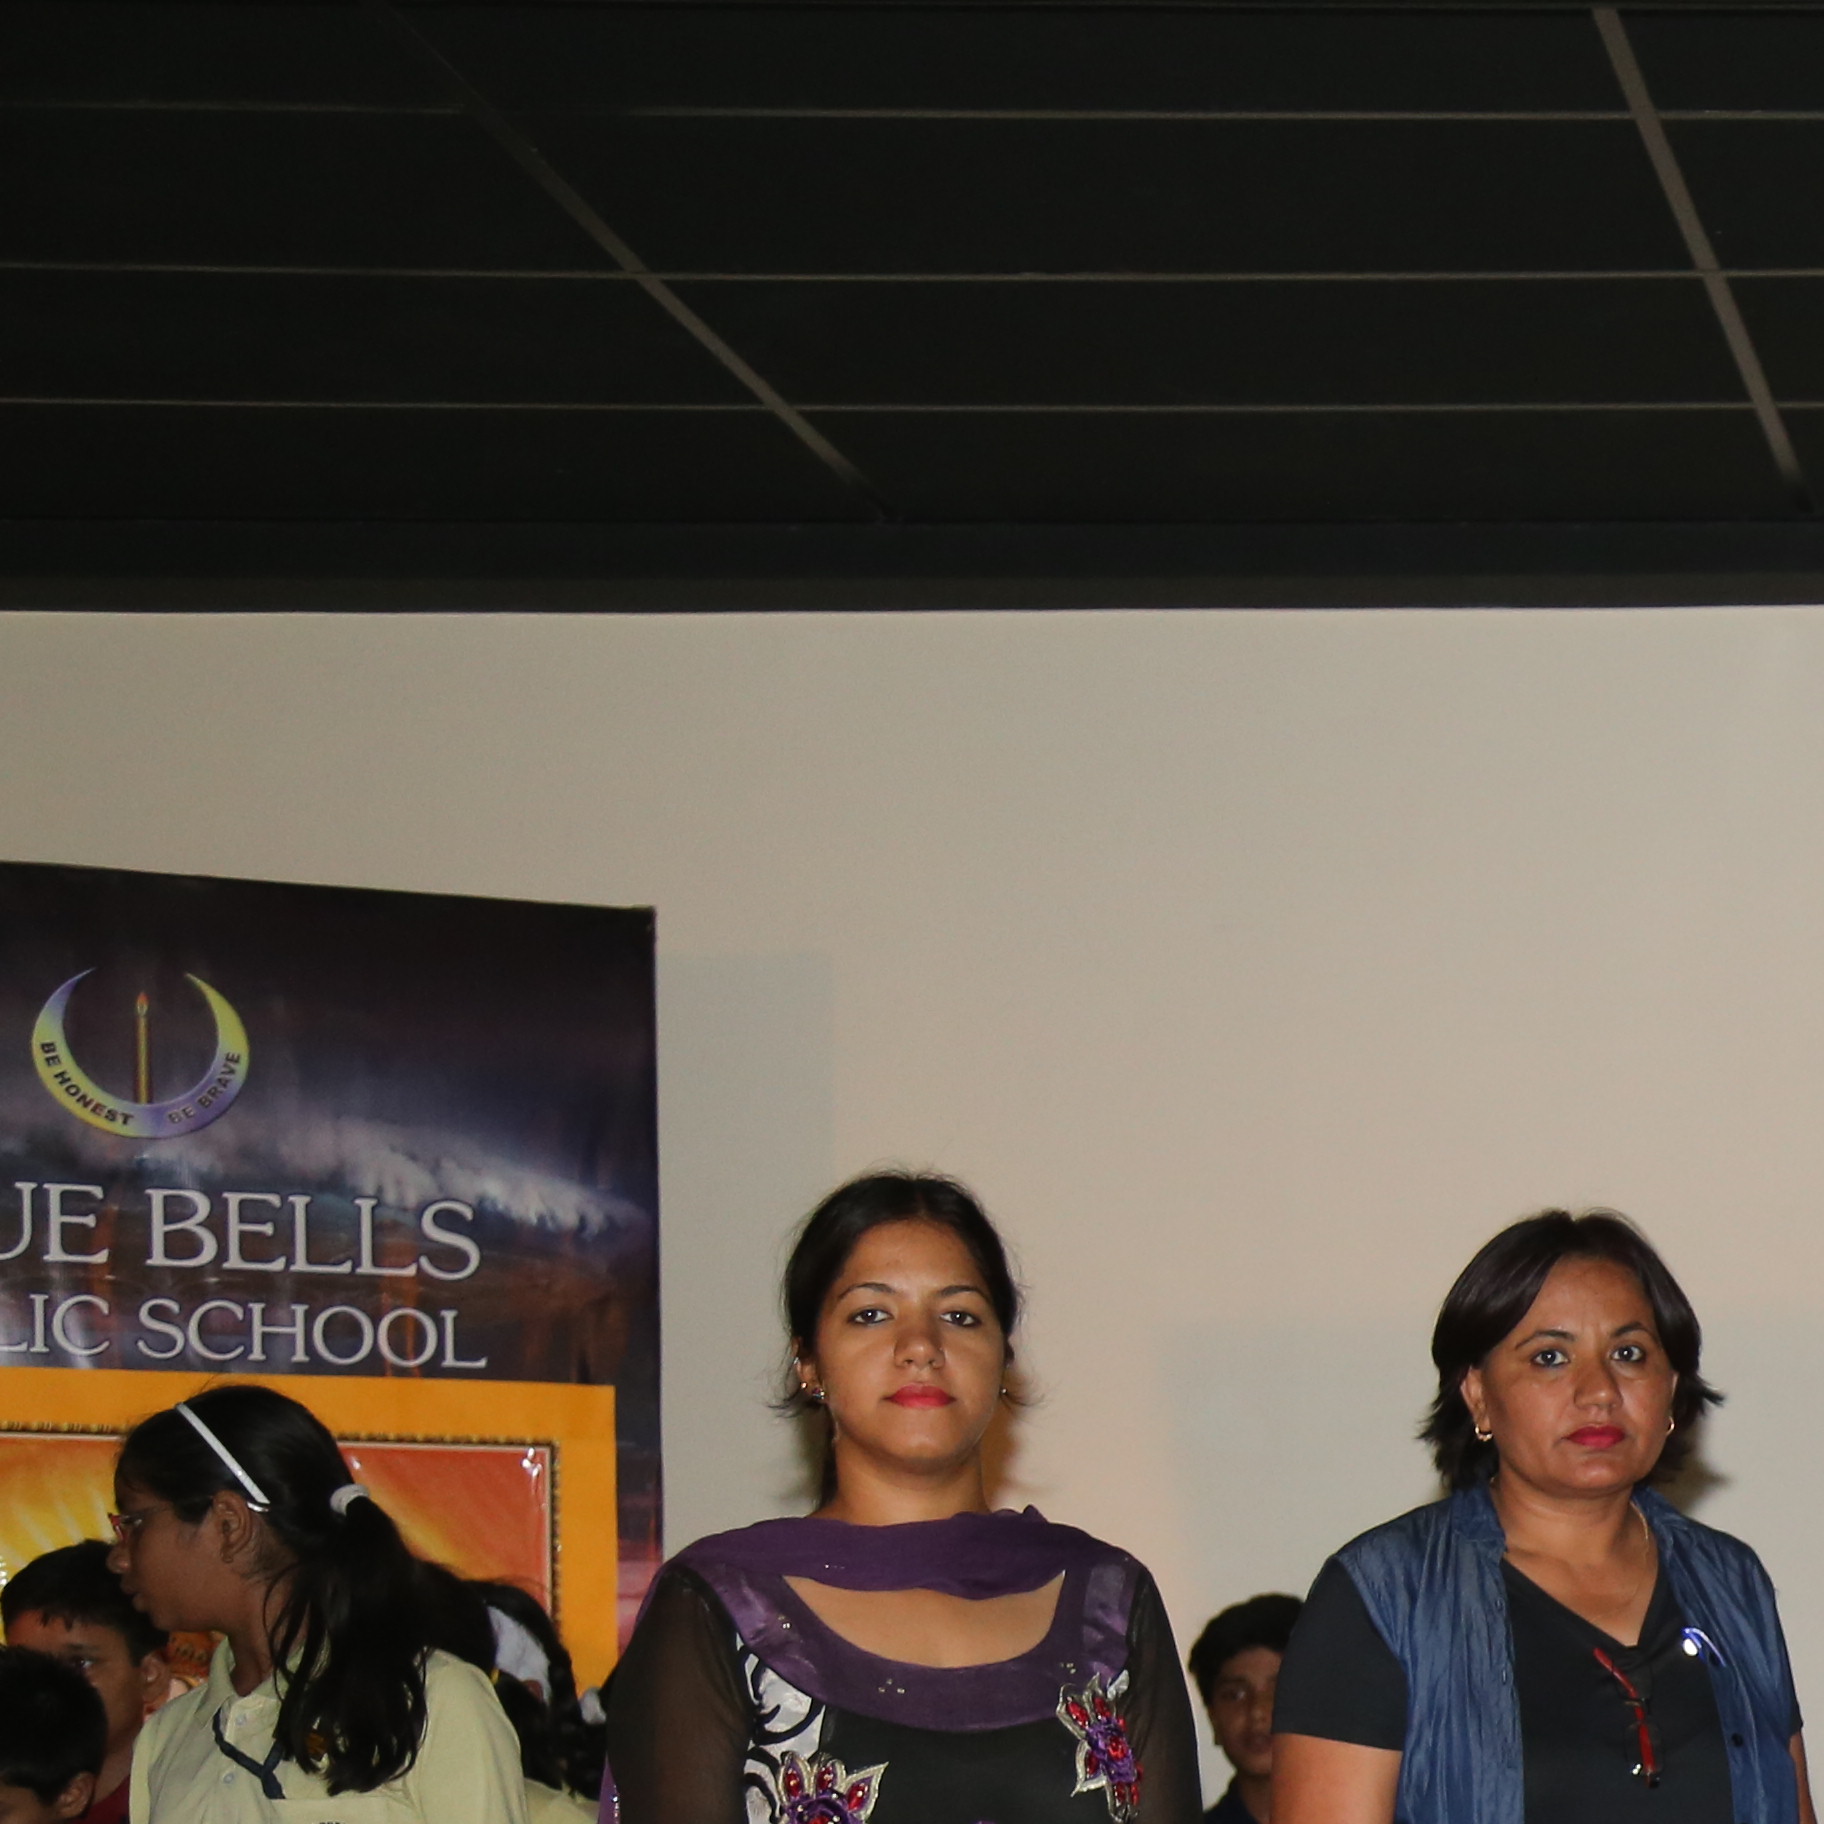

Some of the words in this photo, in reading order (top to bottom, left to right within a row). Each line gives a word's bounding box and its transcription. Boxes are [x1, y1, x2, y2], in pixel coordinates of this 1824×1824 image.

[40, 1041, 62, 1067] BE
[53, 1070, 135, 1126] HONEST
[167, 1105, 196, 1124] BE
[197, 1051, 242, 1109] BRAVE
[144, 1186, 482, 1282] BELLS
[0, 1293, 110, 1357] IC
[137, 1297, 487, 1371] SCHOOL
